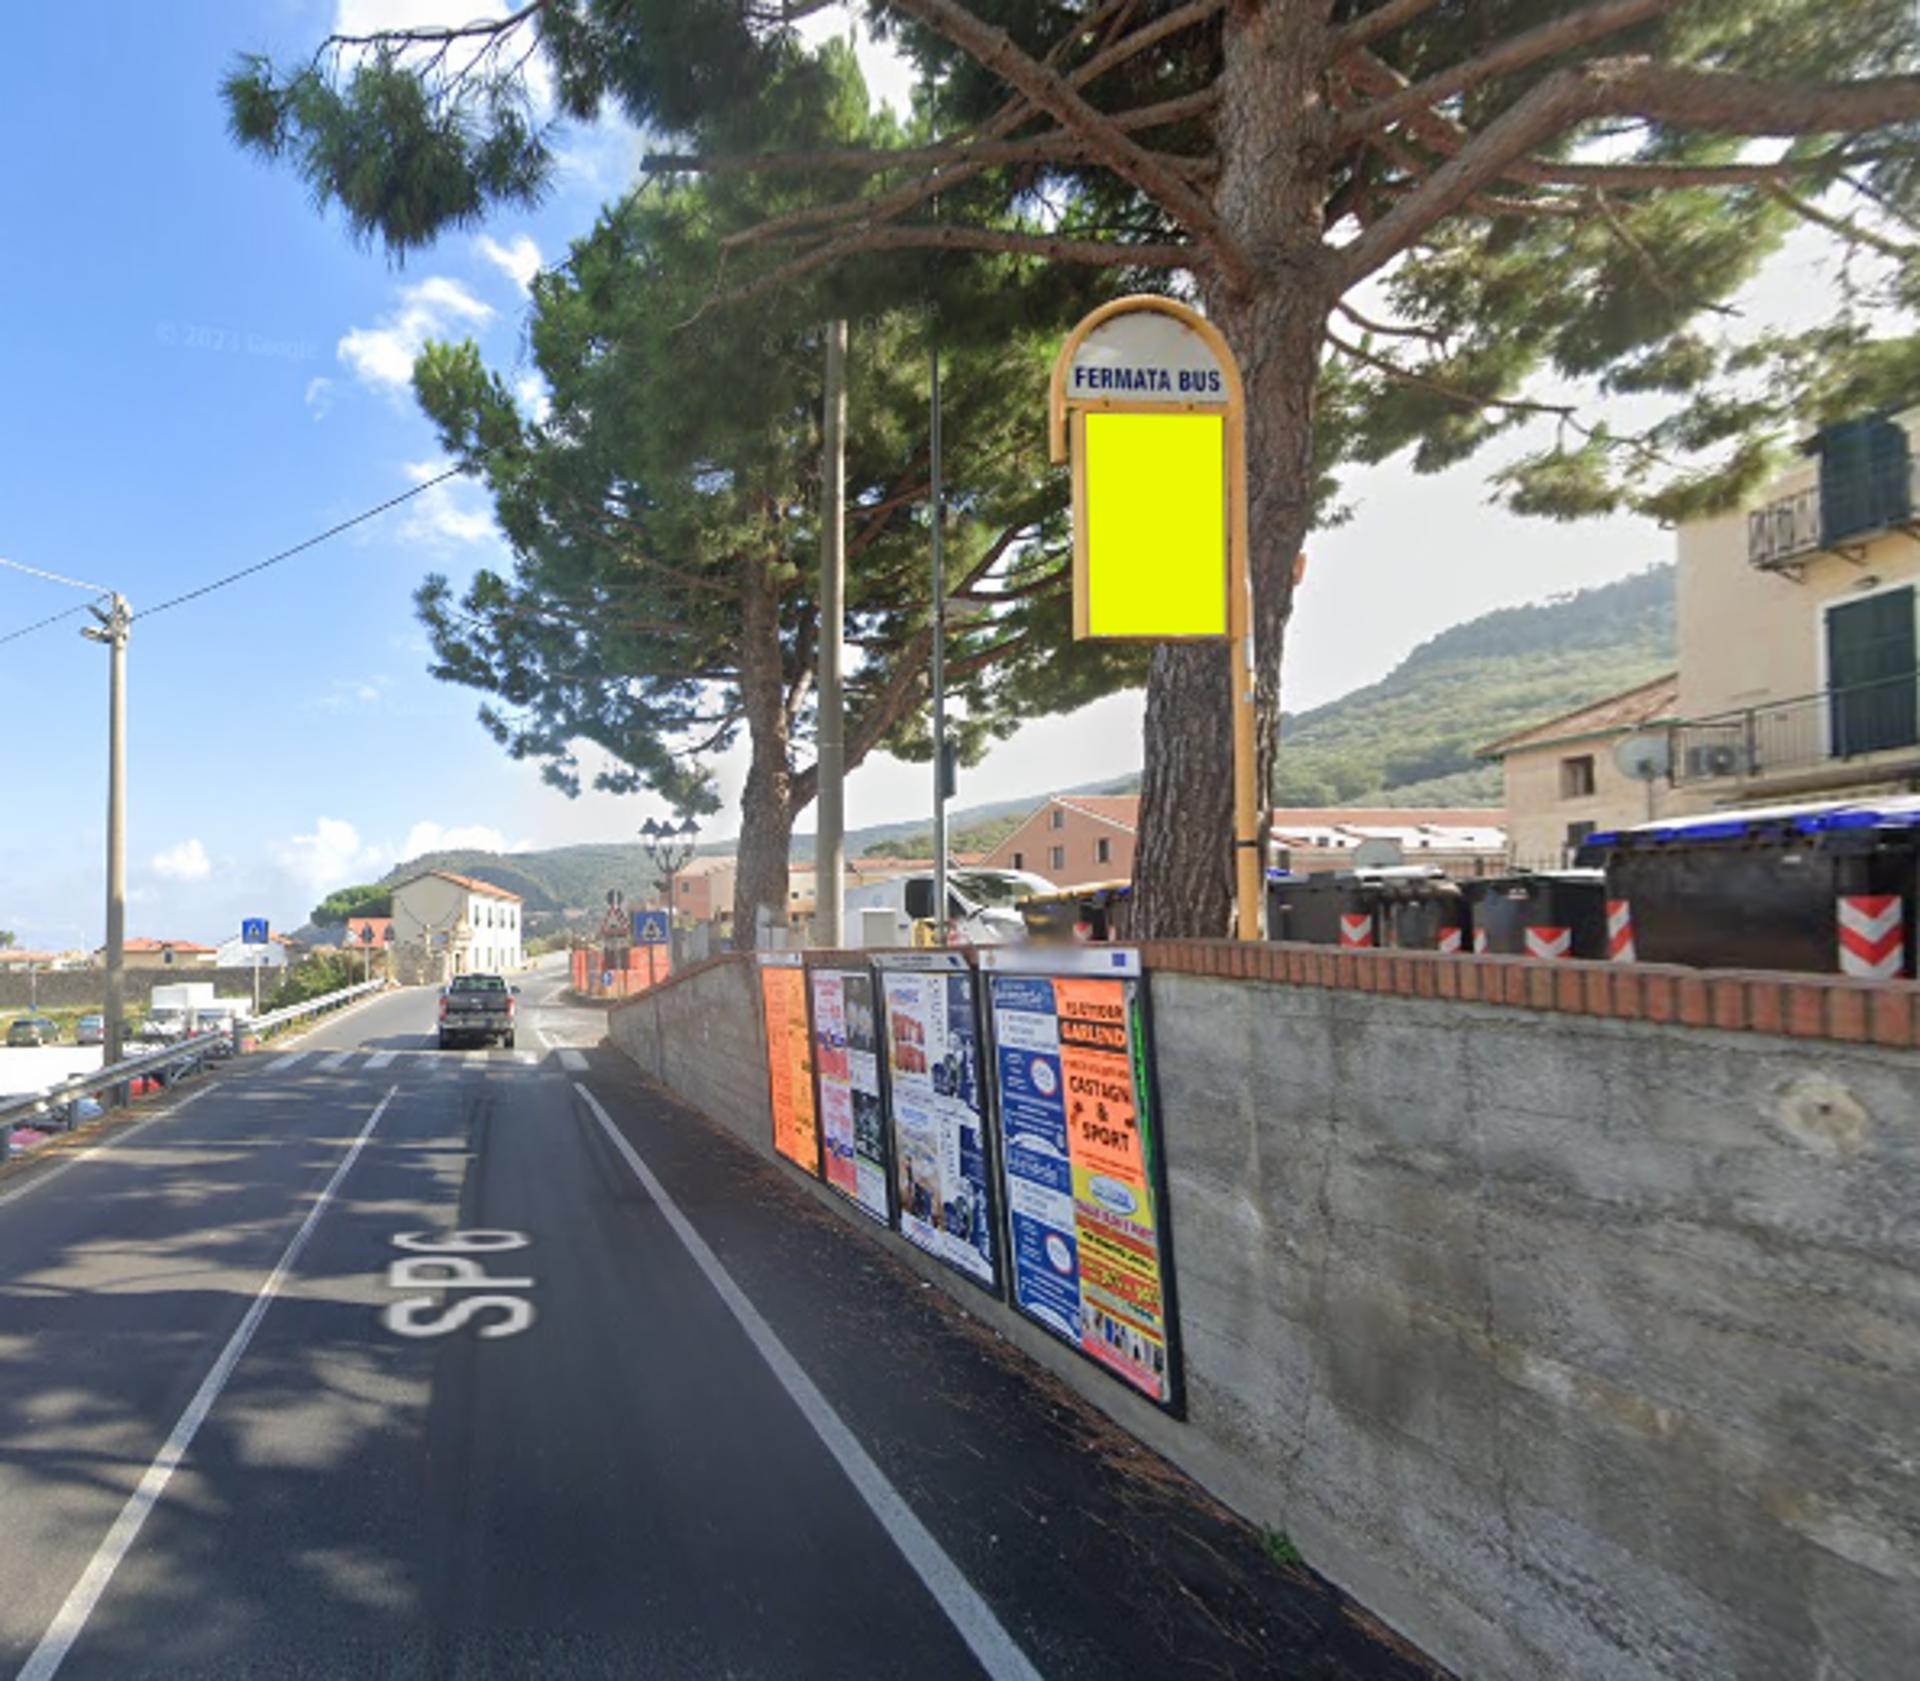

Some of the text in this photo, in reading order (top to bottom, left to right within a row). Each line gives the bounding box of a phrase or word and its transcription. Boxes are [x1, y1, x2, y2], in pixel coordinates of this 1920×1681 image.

[1075, 367, 1221, 392] FERMATA BUS
[1082, 1121, 1129, 1152] SPORT
[388, 1230, 534, 1337] SP6
